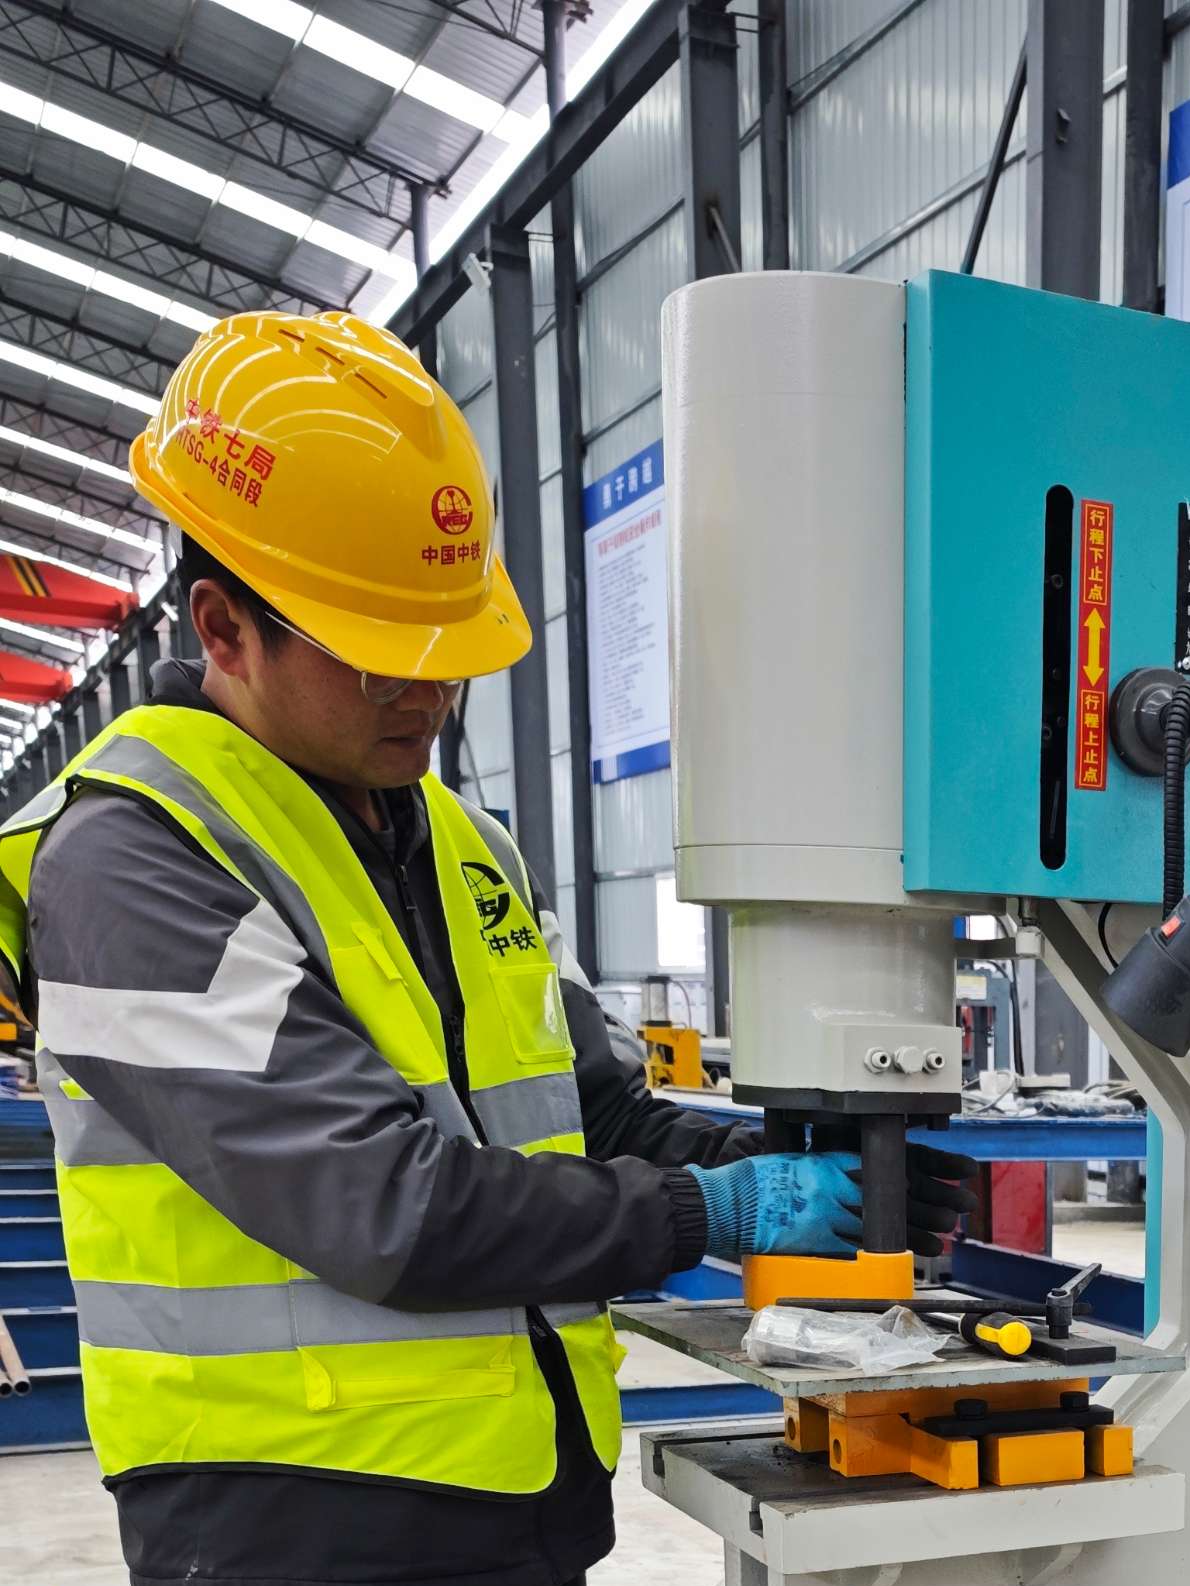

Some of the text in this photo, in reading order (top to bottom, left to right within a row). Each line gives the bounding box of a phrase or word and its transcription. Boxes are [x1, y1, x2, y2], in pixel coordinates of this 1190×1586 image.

[185, 399, 276, 481] 中铁七局
[422, 538, 481, 566] 中国中铁
[1088, 509, 1106, 601] 行程下止点
[1084, 694, 1101, 782] 行程上止点
[480, 926, 537, 957] 中铁
